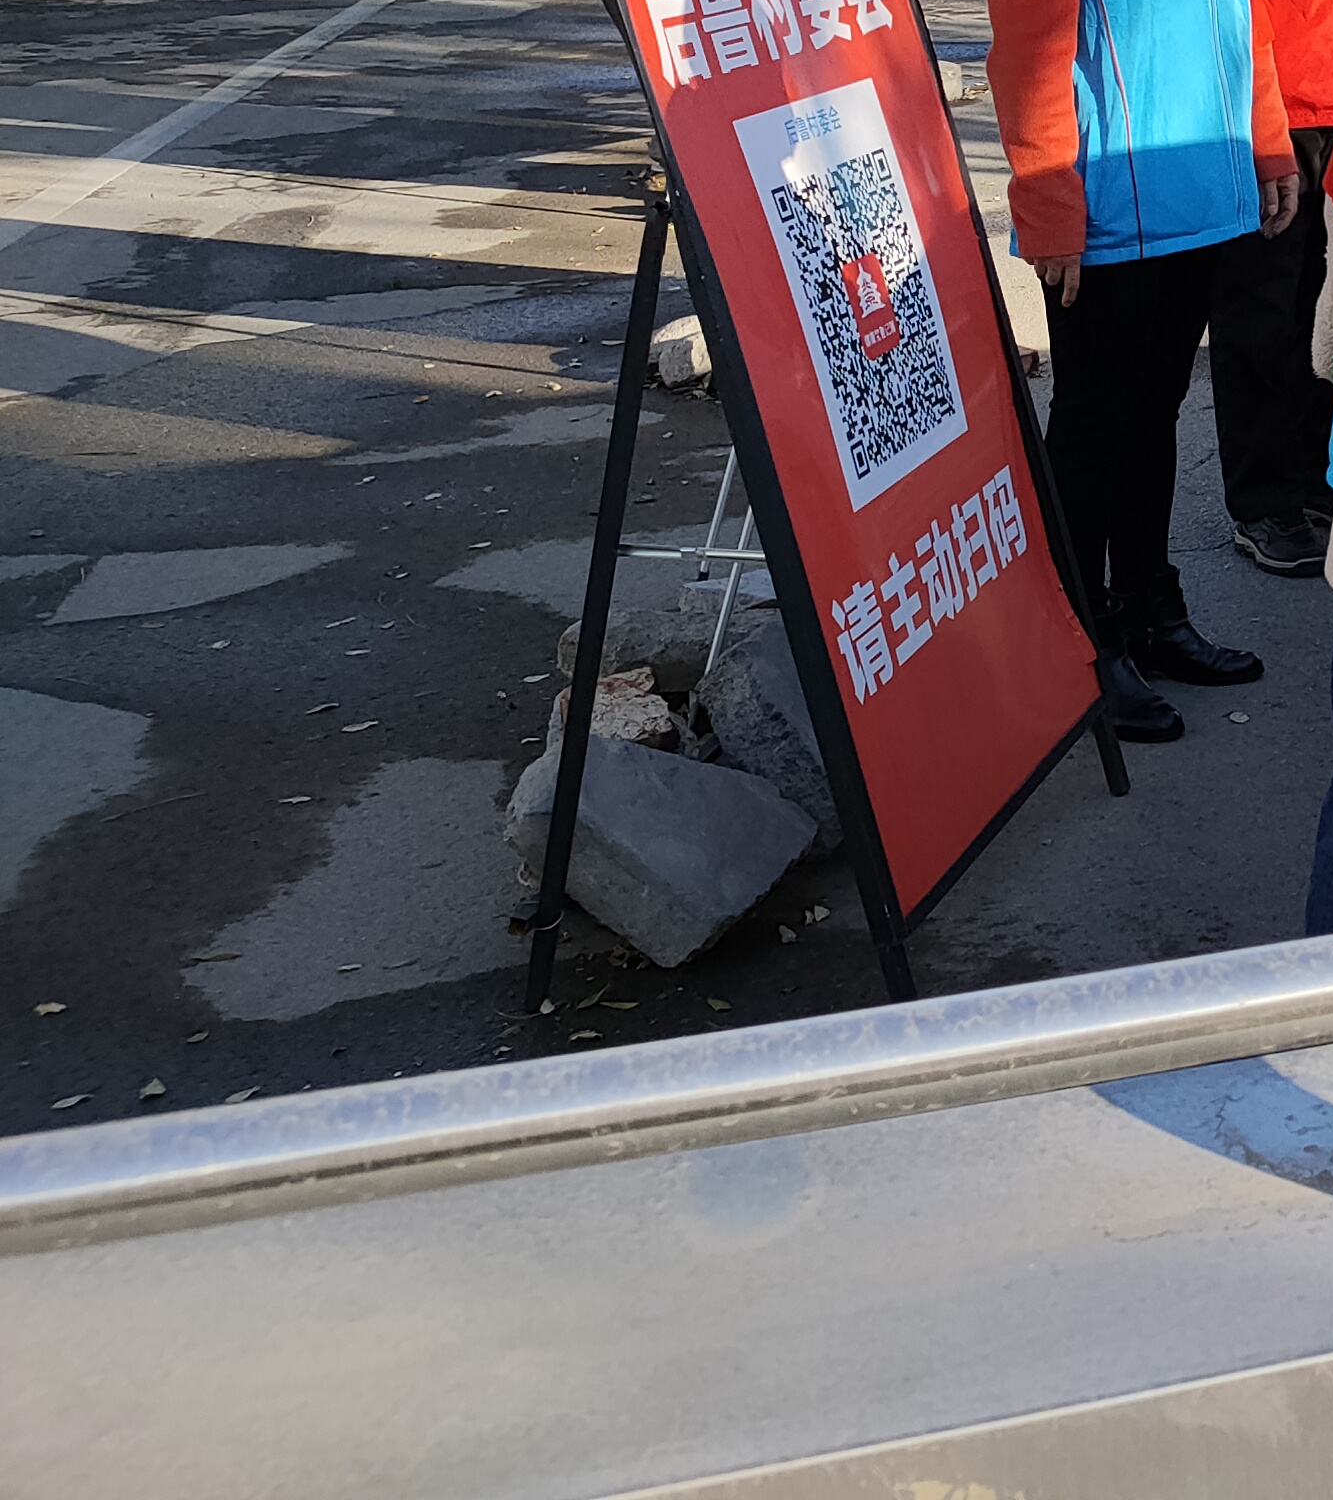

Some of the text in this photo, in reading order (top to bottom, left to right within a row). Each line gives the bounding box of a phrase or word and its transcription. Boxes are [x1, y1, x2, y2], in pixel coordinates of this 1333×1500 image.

[784, 105, 842, 146] 后鲁村委会
[832, 464, 1027, 705] 请主动扫码
